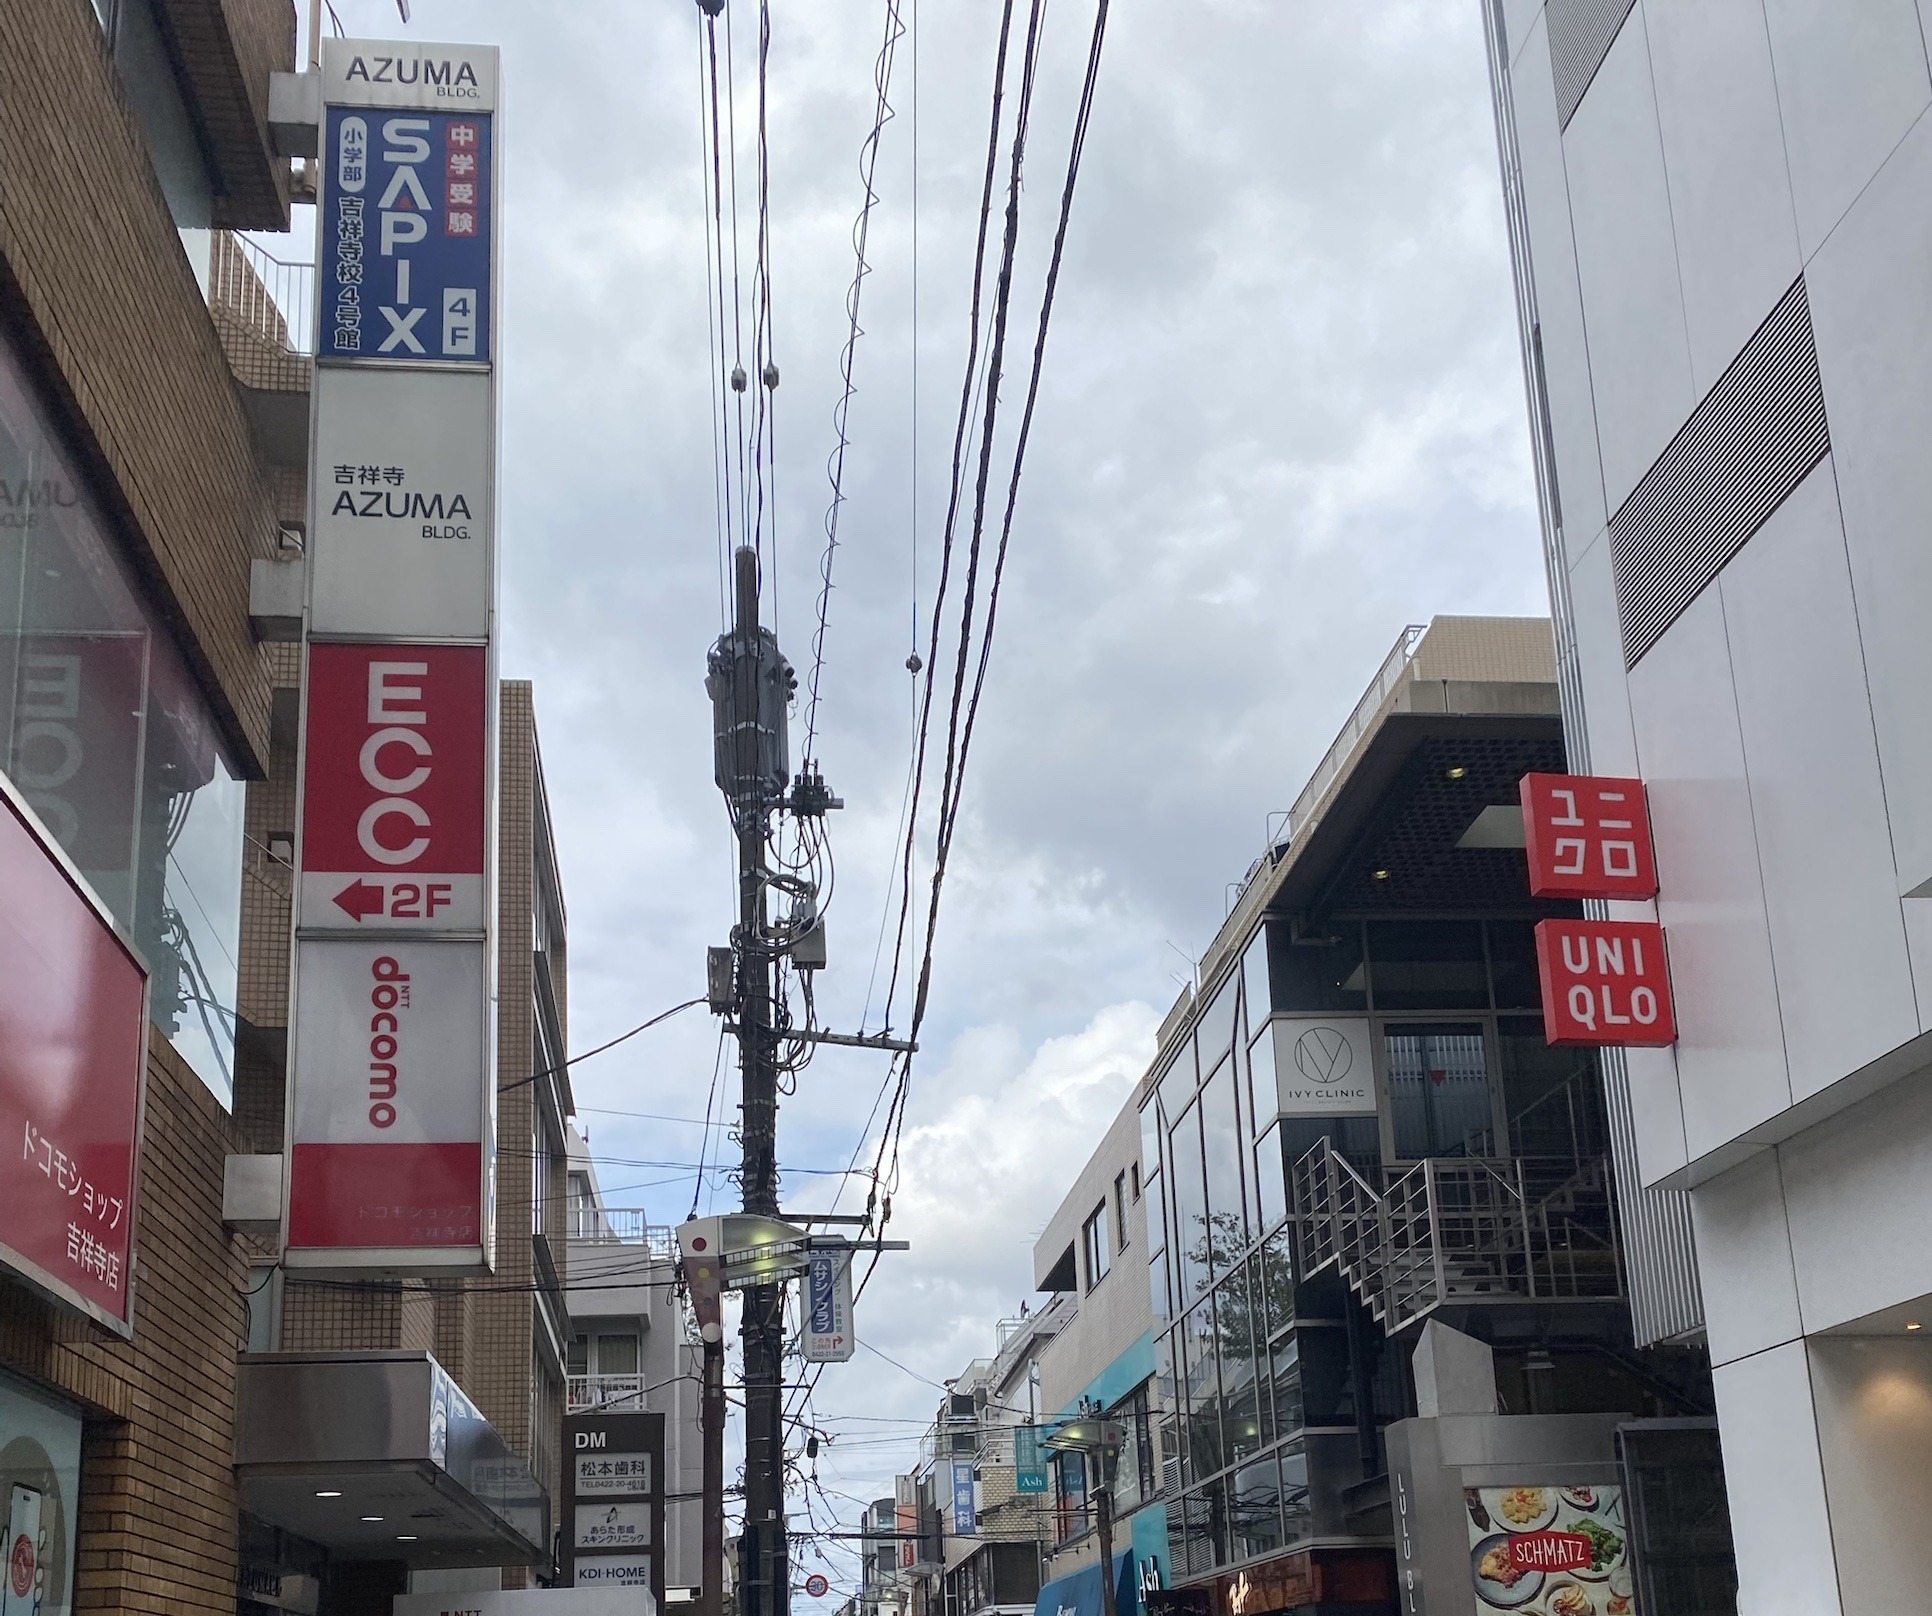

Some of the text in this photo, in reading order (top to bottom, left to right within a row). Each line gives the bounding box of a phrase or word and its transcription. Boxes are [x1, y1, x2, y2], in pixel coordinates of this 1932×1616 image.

[345, 56, 478, 87] AZUMA
[343, 127, 364, 182] 小学部
[447, 125, 475, 234] 中学受験
[377, 118, 433, 354] SAPIX
[335, 196, 365, 351] 吉祥寺校4号館
[448, 297, 471, 347] 4F
[333, 464, 405, 486] 吉祥寺
[331, 490, 472, 520] AZUMA
[421, 525, 471, 540] BLDG.
[356, 661, 434, 866] ECC
[390, 883, 452, 918] 2F
[1561, 935, 1645, 976] UNI
[400, 985, 410, 1009] NTT
[1567, 984, 1658, 1031] QLO
[369, 956, 410, 1128] docomo
[1289, 1089, 1365, 1098] IVY CLINIC
[24, 1120, 123, 1229] ドコモショップ
[67, 1221, 120, 1292] 吉祥寺店
[575, 1431, 607, 1449] DM
[581, 1460, 645, 1476] 松本歯科
[1021, 1476, 1043, 1487] Ash
[955, 1467, 972, 1528] 星歯科
[581, 1535, 645, 1544] スキンクリニック
[590, 1525, 635, 1535] あらた形成
[1515, 1538, 1585, 1567] SCHMATZ
[579, 1566, 646, 1579] KDI-HOME
[810, 1581, 823, 1592] 30
[1138, 1556, 1160, 1603] Ash
